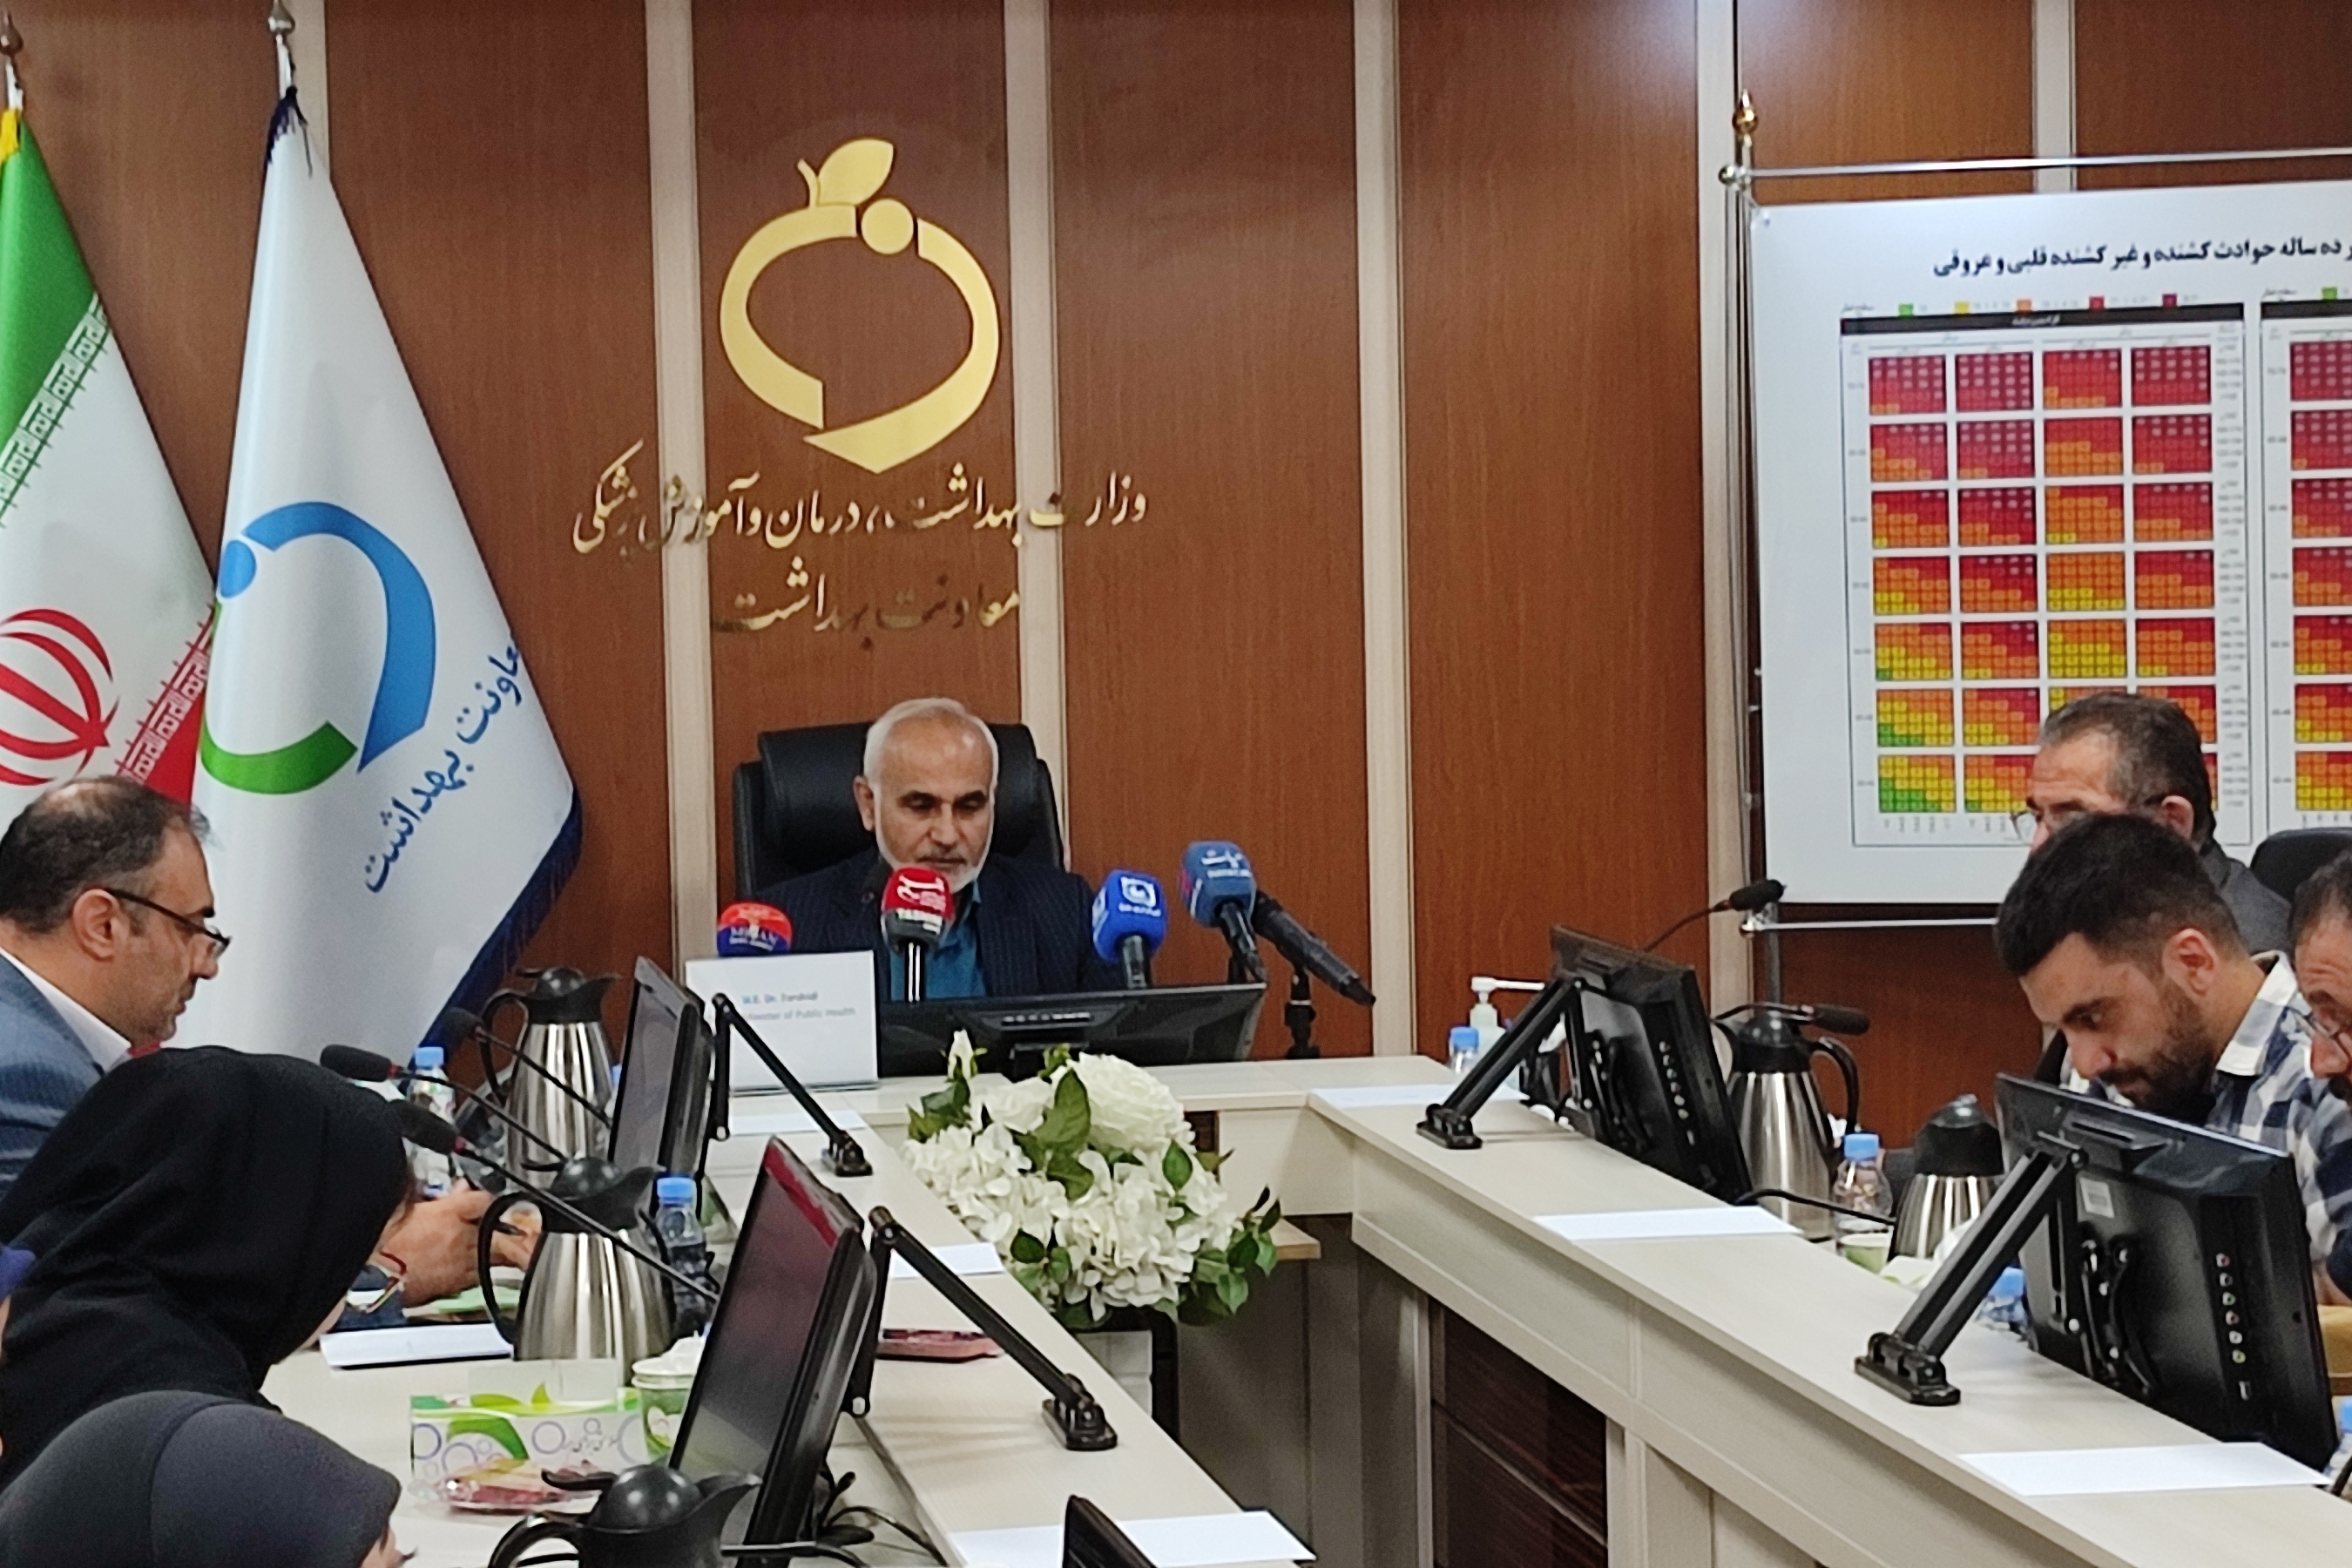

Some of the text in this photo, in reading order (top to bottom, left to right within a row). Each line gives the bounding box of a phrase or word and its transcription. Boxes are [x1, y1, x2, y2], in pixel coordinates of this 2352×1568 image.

[2051, 244, 2108, 267] کشنده
[2109, 243, 2139, 270] غیر
[2153, 240, 2212, 261] کشنده
[2213, 239, 2276, 265] حوادث
[2279, 236, 2318, 257] ساله
[2320, 239, 2342, 256] ده
[1933, 248, 1992, 277] عروقی
[1996, 257, 2005, 275] و
[2006, 246, 2048, 274] قلبی
[2142, 251, 2152, 269] و
[1029, 470, 1147, 528] وزارت
[765, 490, 861, 549] درمان
[364, 645, 523, 894] عاونت بهداشت
